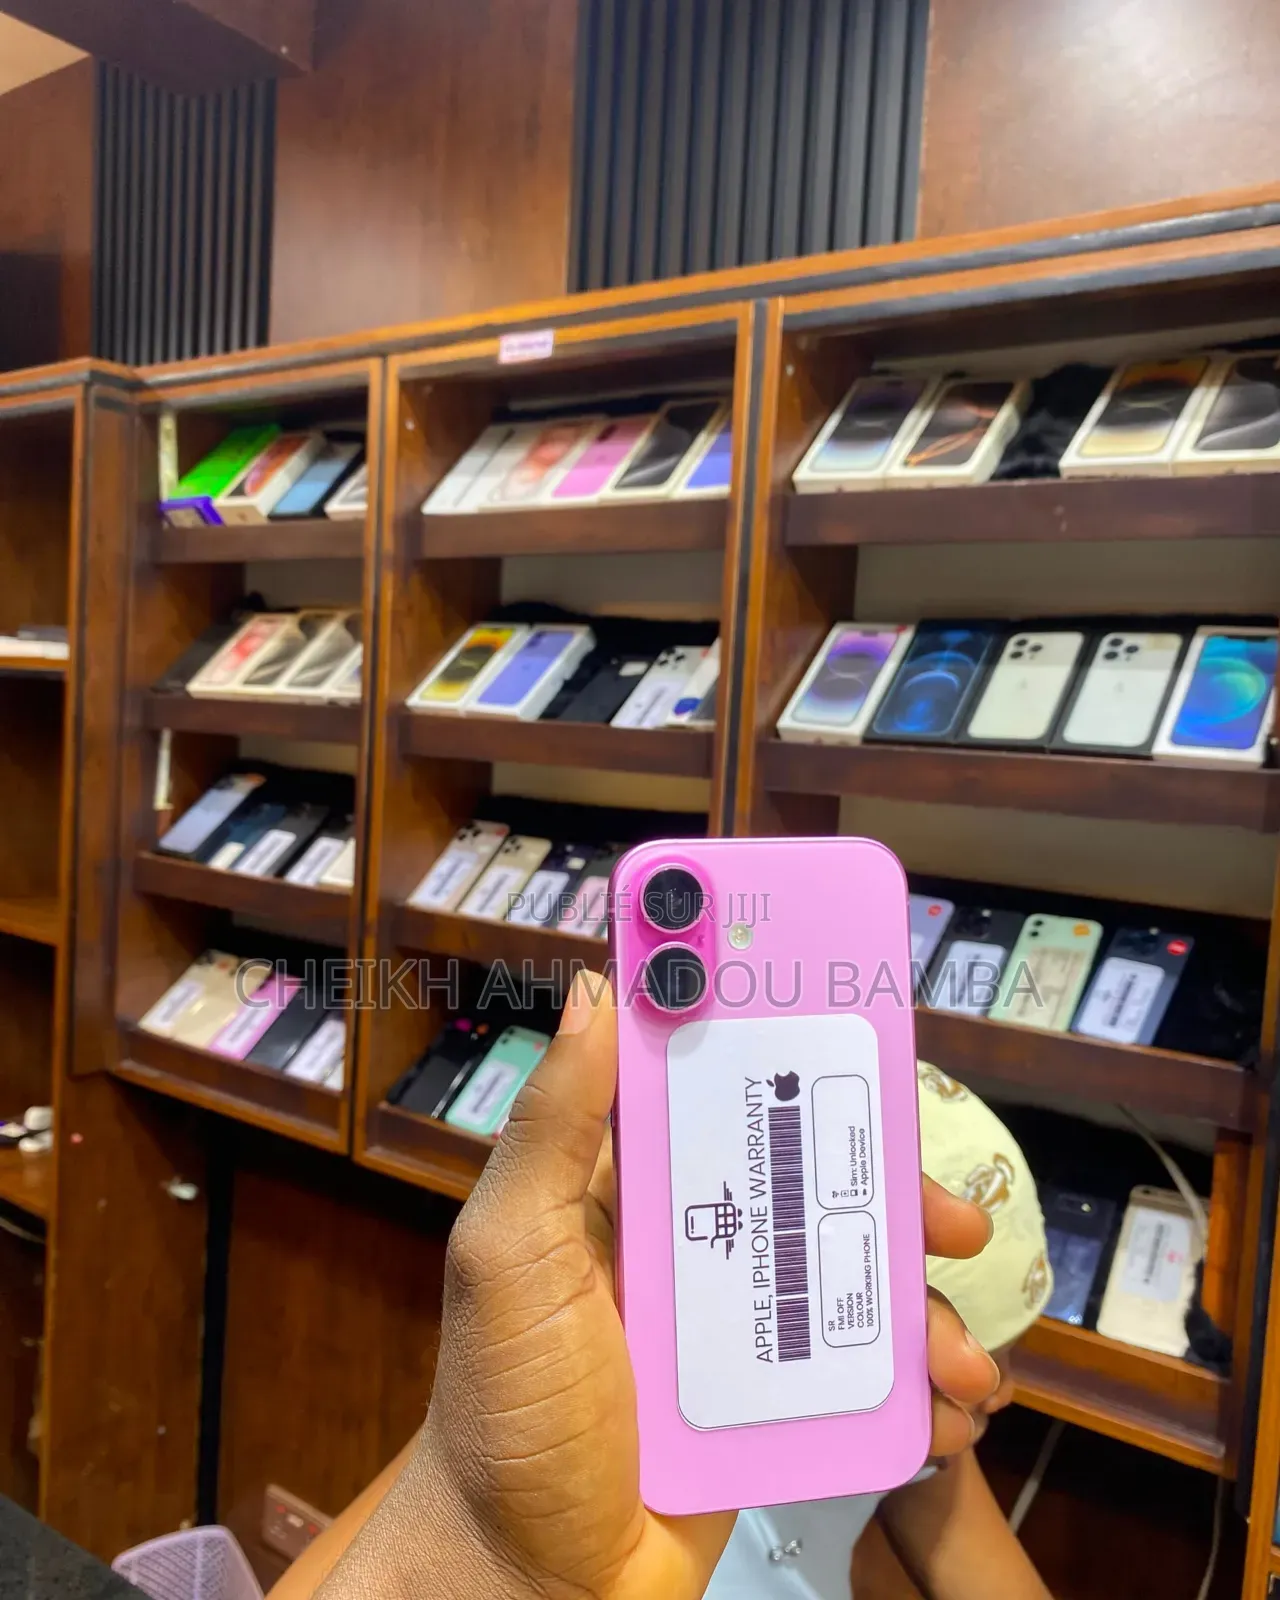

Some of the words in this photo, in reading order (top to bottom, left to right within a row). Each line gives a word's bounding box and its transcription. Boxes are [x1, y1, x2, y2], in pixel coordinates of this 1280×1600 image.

[745, 1076, 767, 1200] WARRANTY
[848, 1125, 857, 1167] Unlocked
[858, 1128, 867, 1159] Device
[859, 1160, 869, 1186] Apple
[751, 1206, 770, 1289] IPHONE
[862, 1233, 871, 1263] PHONE
[864, 1264, 873, 1307] WORKING
[836, 1297, 845, 1314] OFF
[846, 1292, 855, 1330] VERSION
[856, 1291, 864, 1329] COLOUR
[866, 1308, 874, 1327] 100%
[754, 1294, 773, 1363] APPLE,
